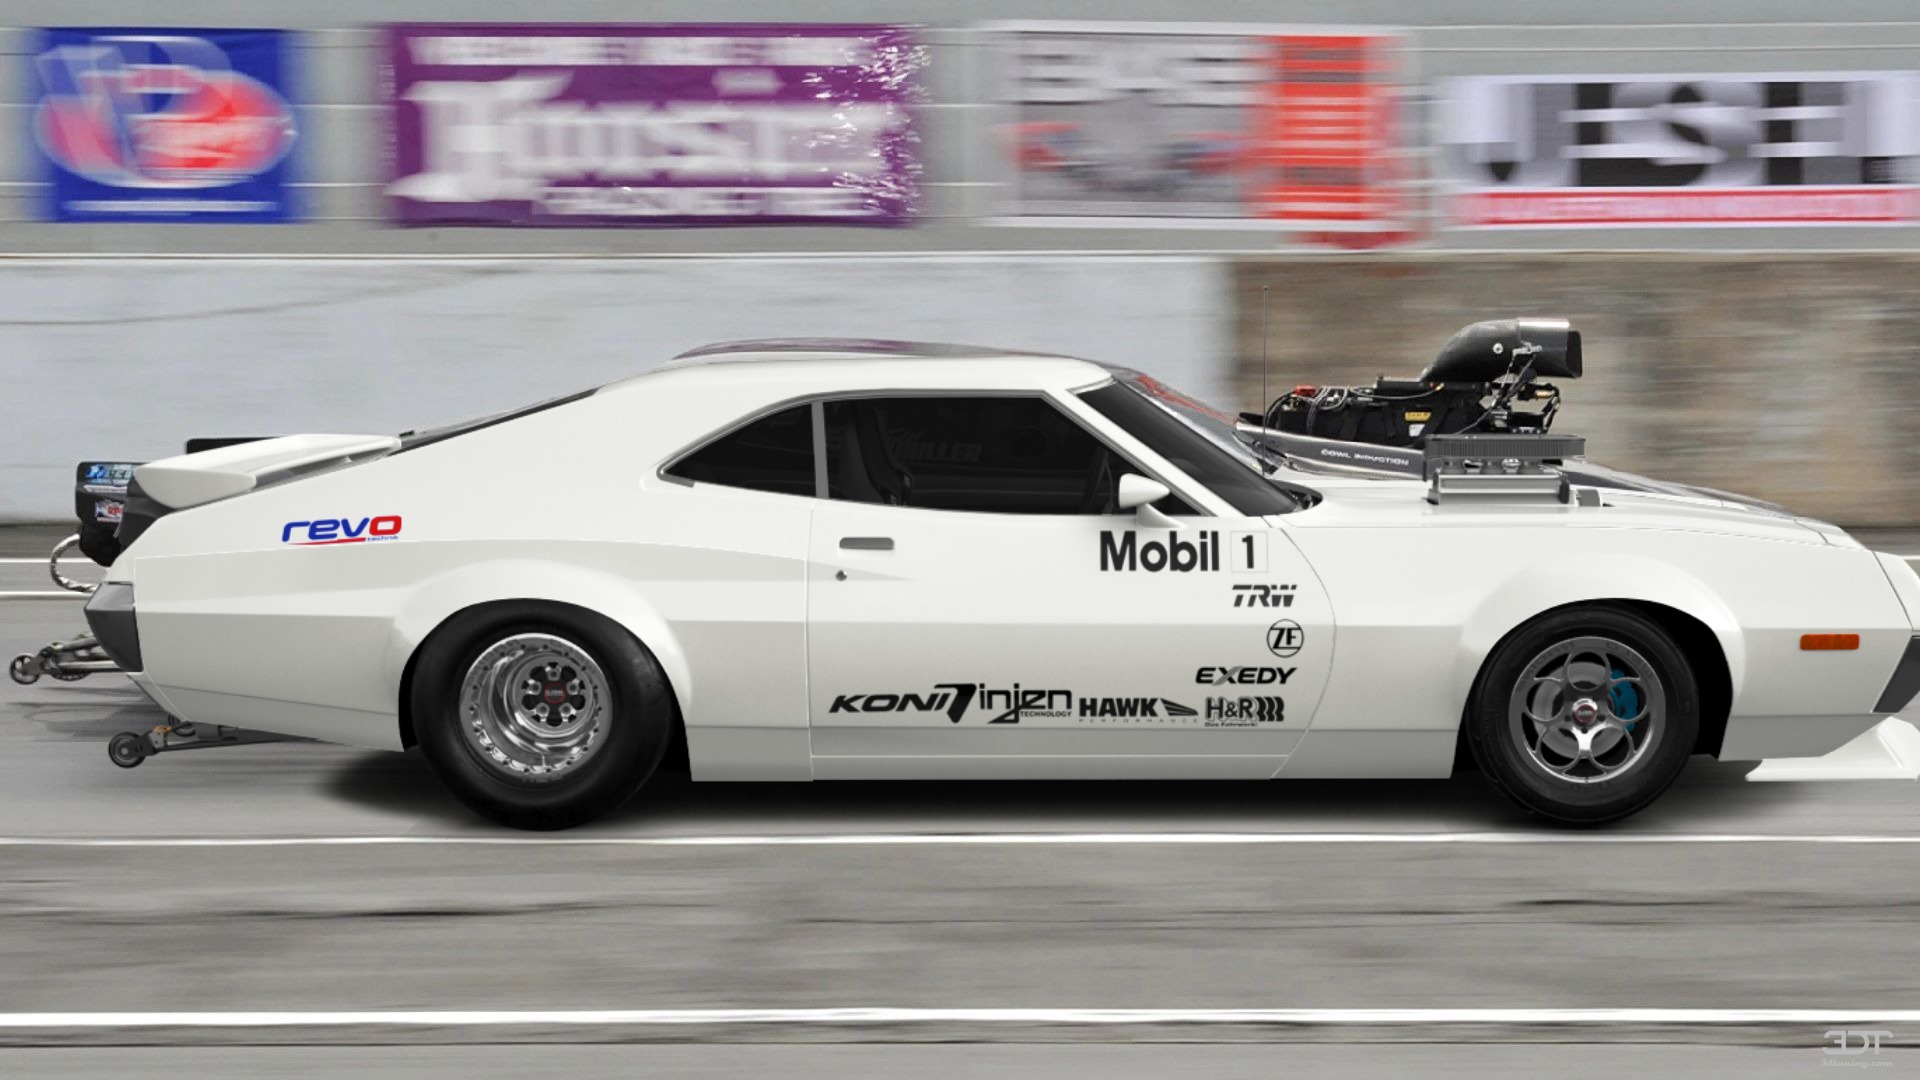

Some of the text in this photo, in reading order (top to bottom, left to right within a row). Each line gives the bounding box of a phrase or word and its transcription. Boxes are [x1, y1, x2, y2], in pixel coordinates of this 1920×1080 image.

[1320, 448, 1409, 466] COWL INDUCTION
[282, 515, 402, 542] revo
[1100, 530, 1254, 572] Mobil 1
[1232, 584, 1297, 607] TRW
[1268, 626, 1302, 651] ZF
[1195, 666, 1298, 686] EXEDY
[829, 690, 956, 713] KONI
[979, 683, 1072, 724] injen
[1079, 698, 1159, 717] HAWK
[1204, 696, 1256, 721] H&R
